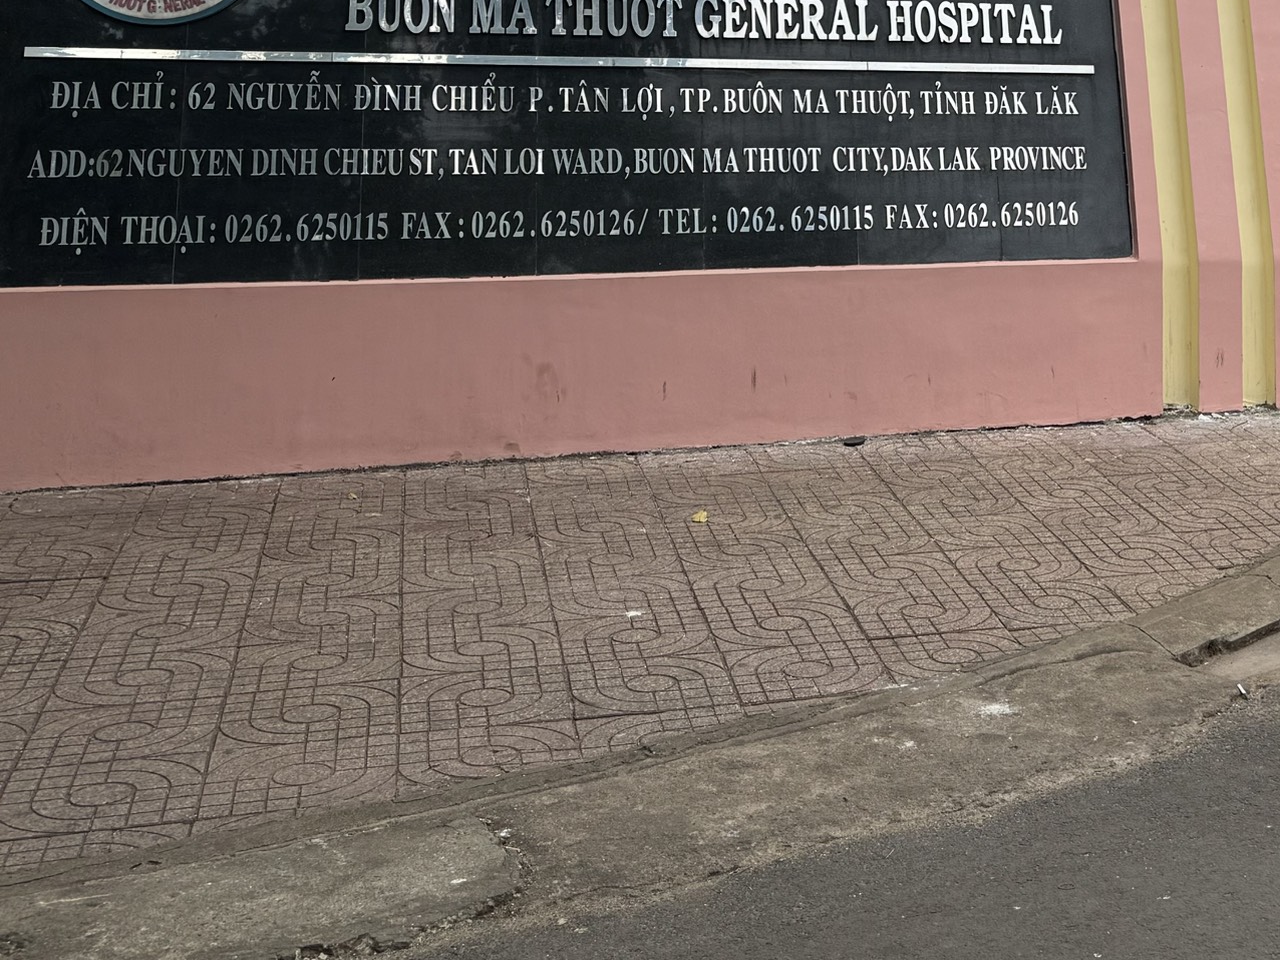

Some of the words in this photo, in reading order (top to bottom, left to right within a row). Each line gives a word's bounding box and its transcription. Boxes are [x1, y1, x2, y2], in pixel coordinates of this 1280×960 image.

[886, 0, 1063, 45] HOSPITAL
[50, 81, 101, 118] ĐỊA
[188, 82, 216, 110] 62
[226, 70, 341, 111] NGUYỄN
[353, 77, 421, 112] ĐÌNH
[431, 72, 515, 113] CHIỂU
[793, 88, 830, 114] MA
[835, 83, 915, 122] THUỘT,
[919, 81, 976, 115] TỈNH
[984, 85, 1028, 116] ĐĂK
[1035, 85, 1080, 116] LĂK
[250, 148, 318, 176] DINH
[323, 147, 404, 176] CHIEU
[503, 148, 545, 175] LOI
[702, 148, 740, 173] MA
[743, 146, 822, 173] THUOT
[938, 146, 982, 172] LAK
[989, 145, 1088, 172] PROVINCE
[38, 207, 110, 255] ĐIỆN
